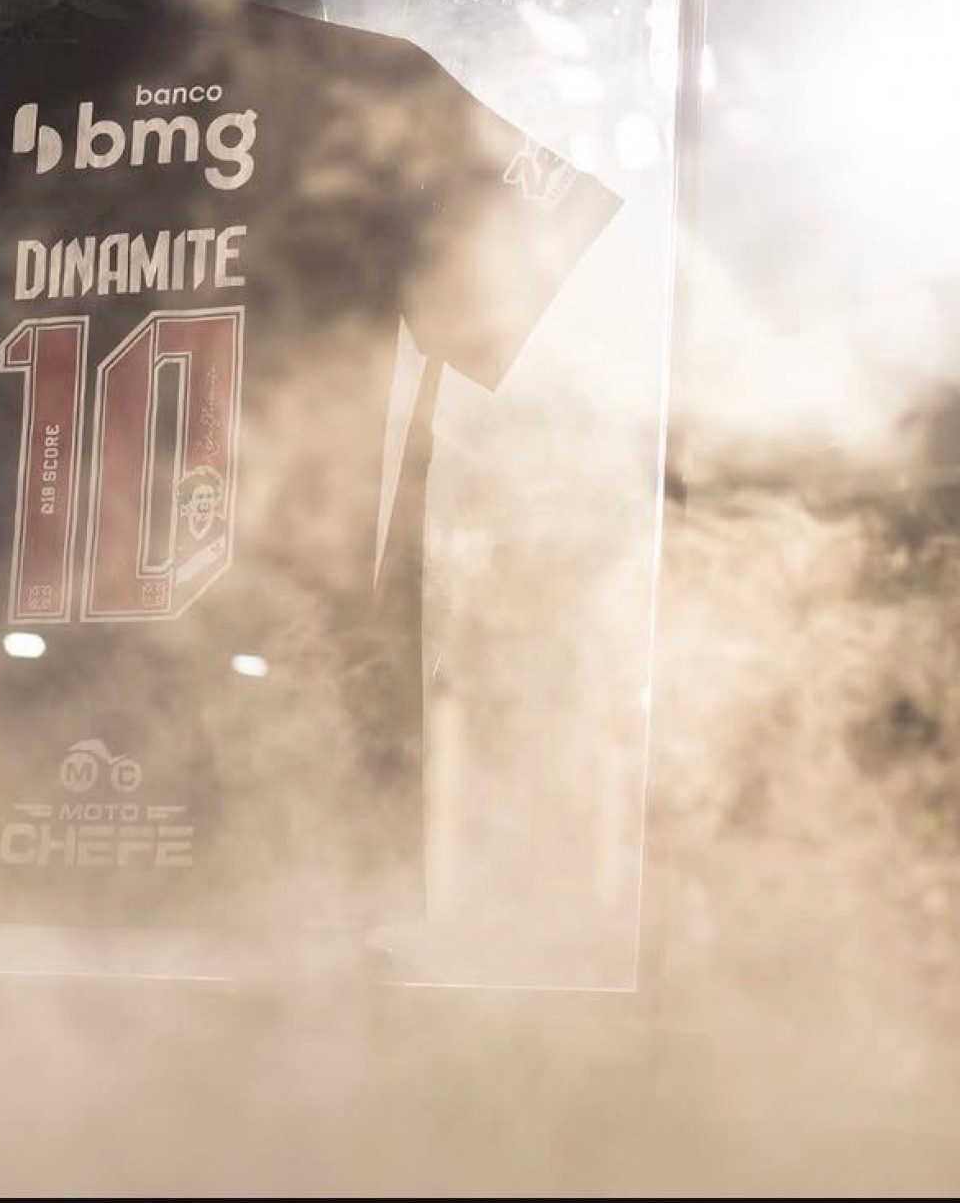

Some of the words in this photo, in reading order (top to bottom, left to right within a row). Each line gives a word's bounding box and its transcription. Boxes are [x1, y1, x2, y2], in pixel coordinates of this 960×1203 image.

[136, 85, 222, 106] banco
[75, 101, 257, 190] bmg
[14, 225, 247, 301] DINAMITE
[43, 425, 60, 482] SCORE
[58, 803, 140, 821] MOTO
[0, 823, 194, 867] CHEFE
